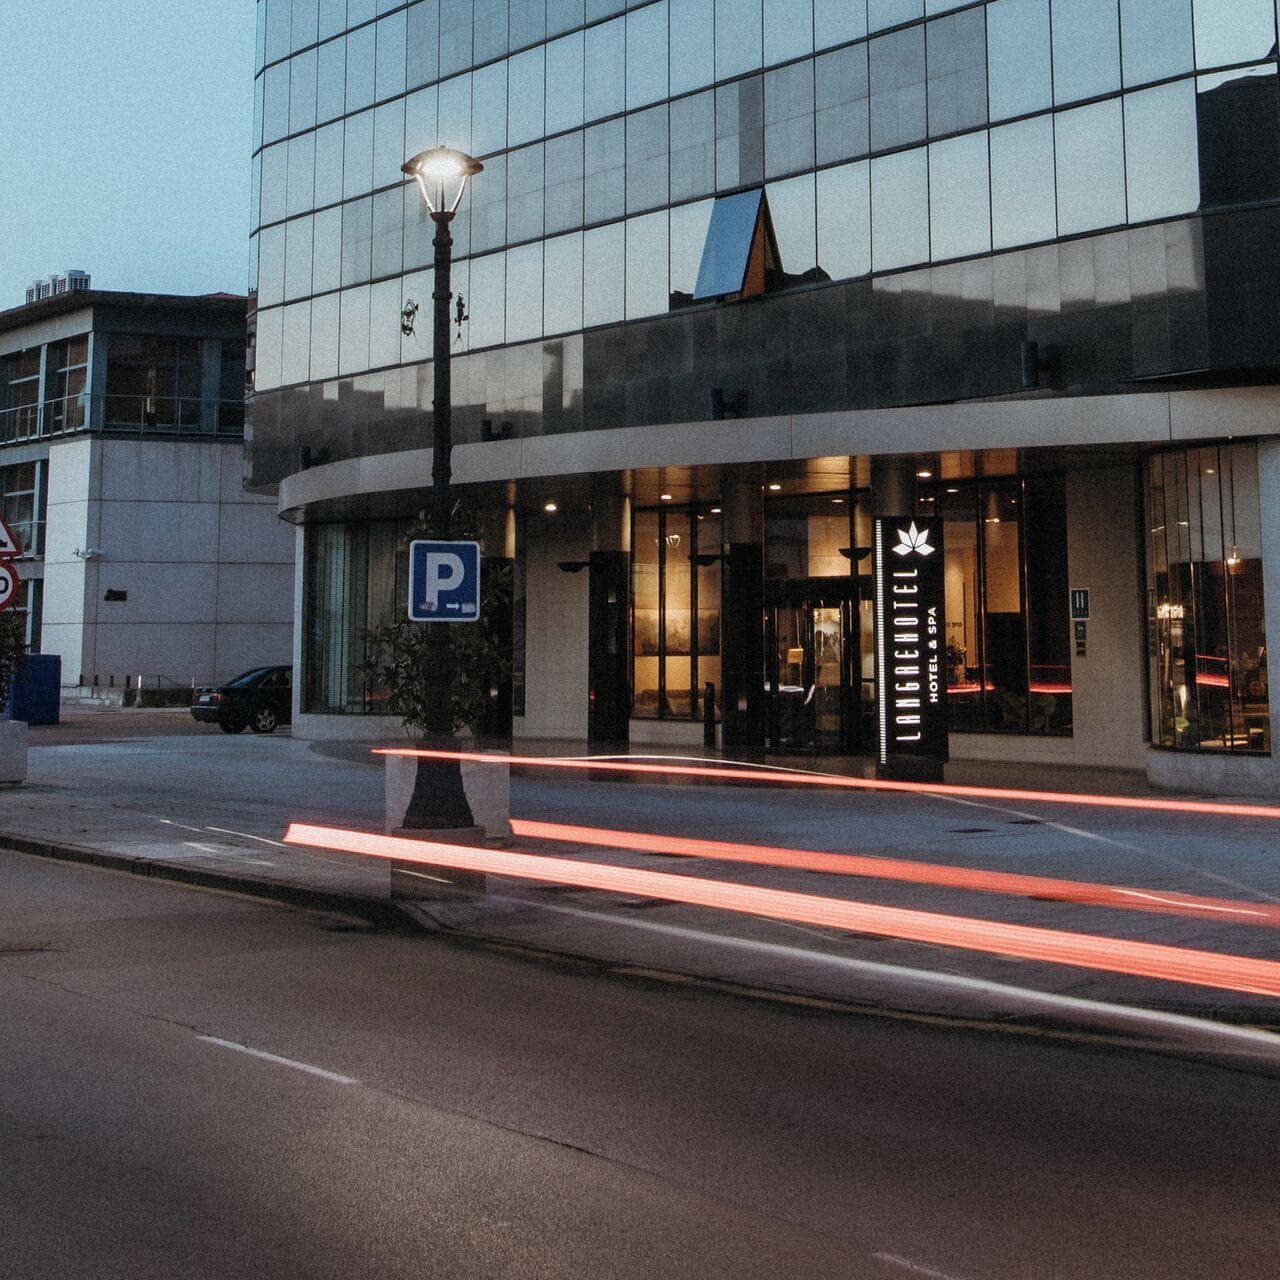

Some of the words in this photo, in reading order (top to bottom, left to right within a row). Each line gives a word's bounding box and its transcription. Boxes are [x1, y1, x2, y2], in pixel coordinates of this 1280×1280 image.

[425, 552, 465, 611] P
[927, 606, 937, 634] SPA
[928, 639, 937, 649] &
[893, 568, 921, 741] LANGREHOTEL
[929, 654, 938, 703] HOTEL
